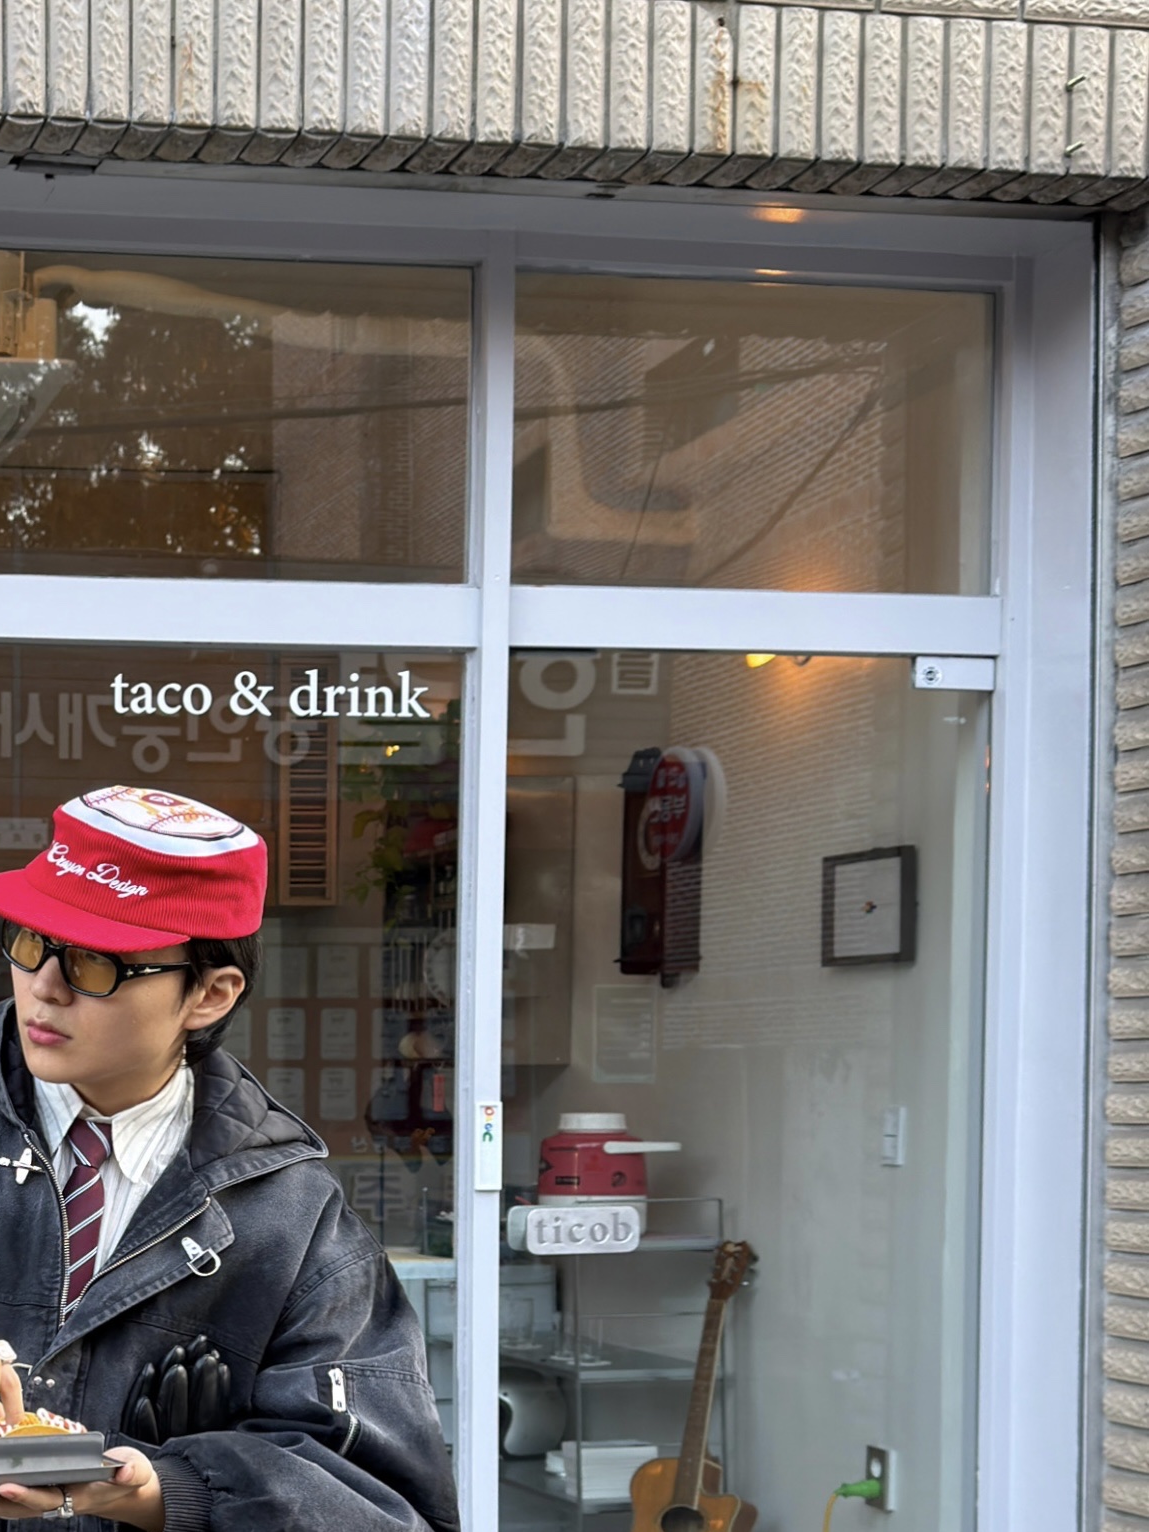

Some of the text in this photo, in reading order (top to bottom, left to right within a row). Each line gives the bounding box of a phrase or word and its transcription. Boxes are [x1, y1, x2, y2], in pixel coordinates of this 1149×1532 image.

[110, 673, 213, 715] taco
[229, 671, 274, 716] &
[289, 669, 431, 717] drink
[86, 863, 148, 898] Design
[535, 1212, 633, 1246] ticob
